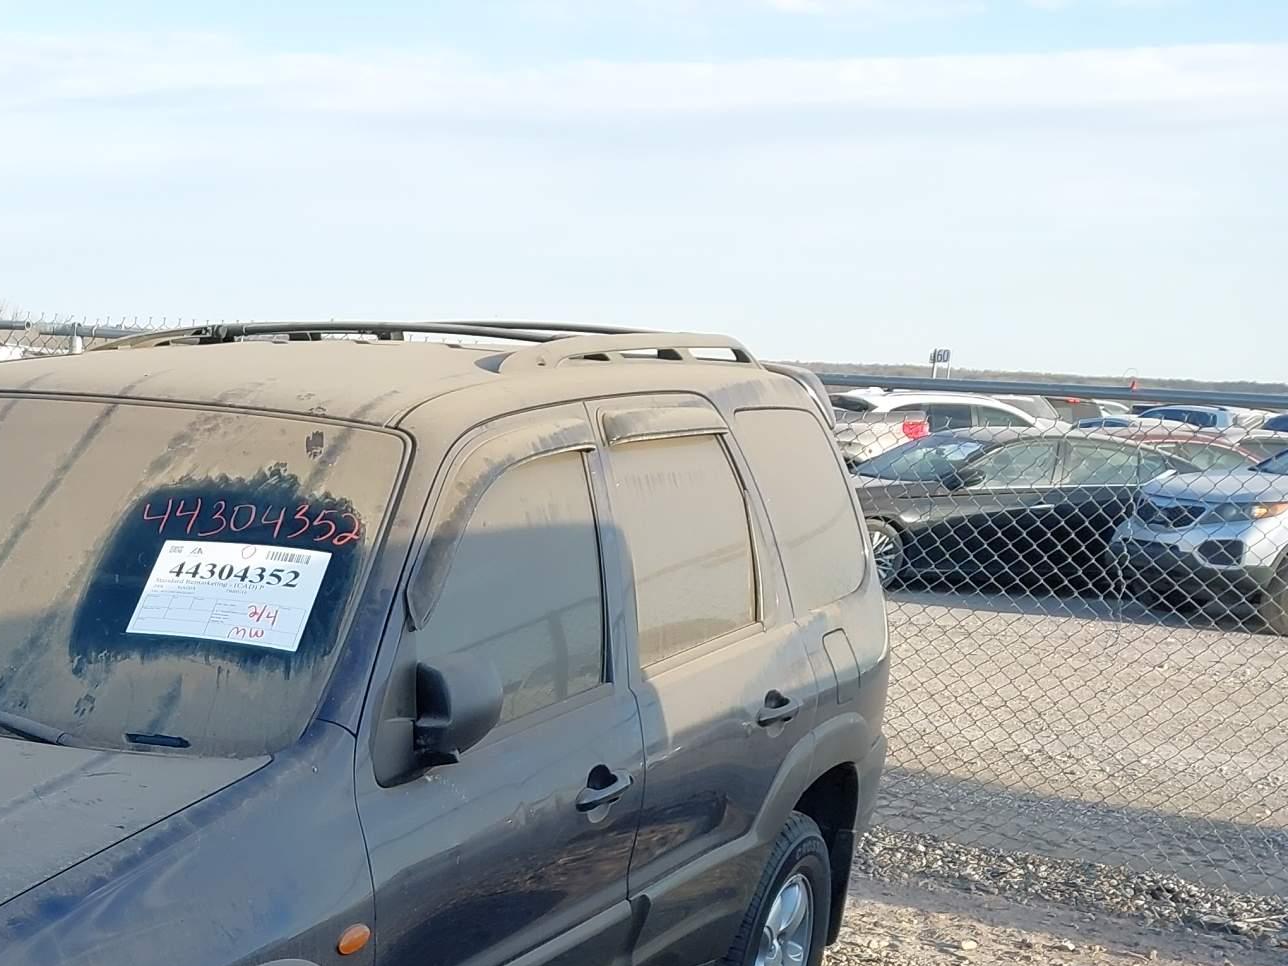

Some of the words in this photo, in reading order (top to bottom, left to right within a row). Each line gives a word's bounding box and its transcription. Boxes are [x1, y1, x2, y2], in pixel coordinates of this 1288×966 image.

[143, 498, 362, 545] 44304352
[169, 561, 300, 588] 44304352
[248, 605, 278, 626] 2/4
